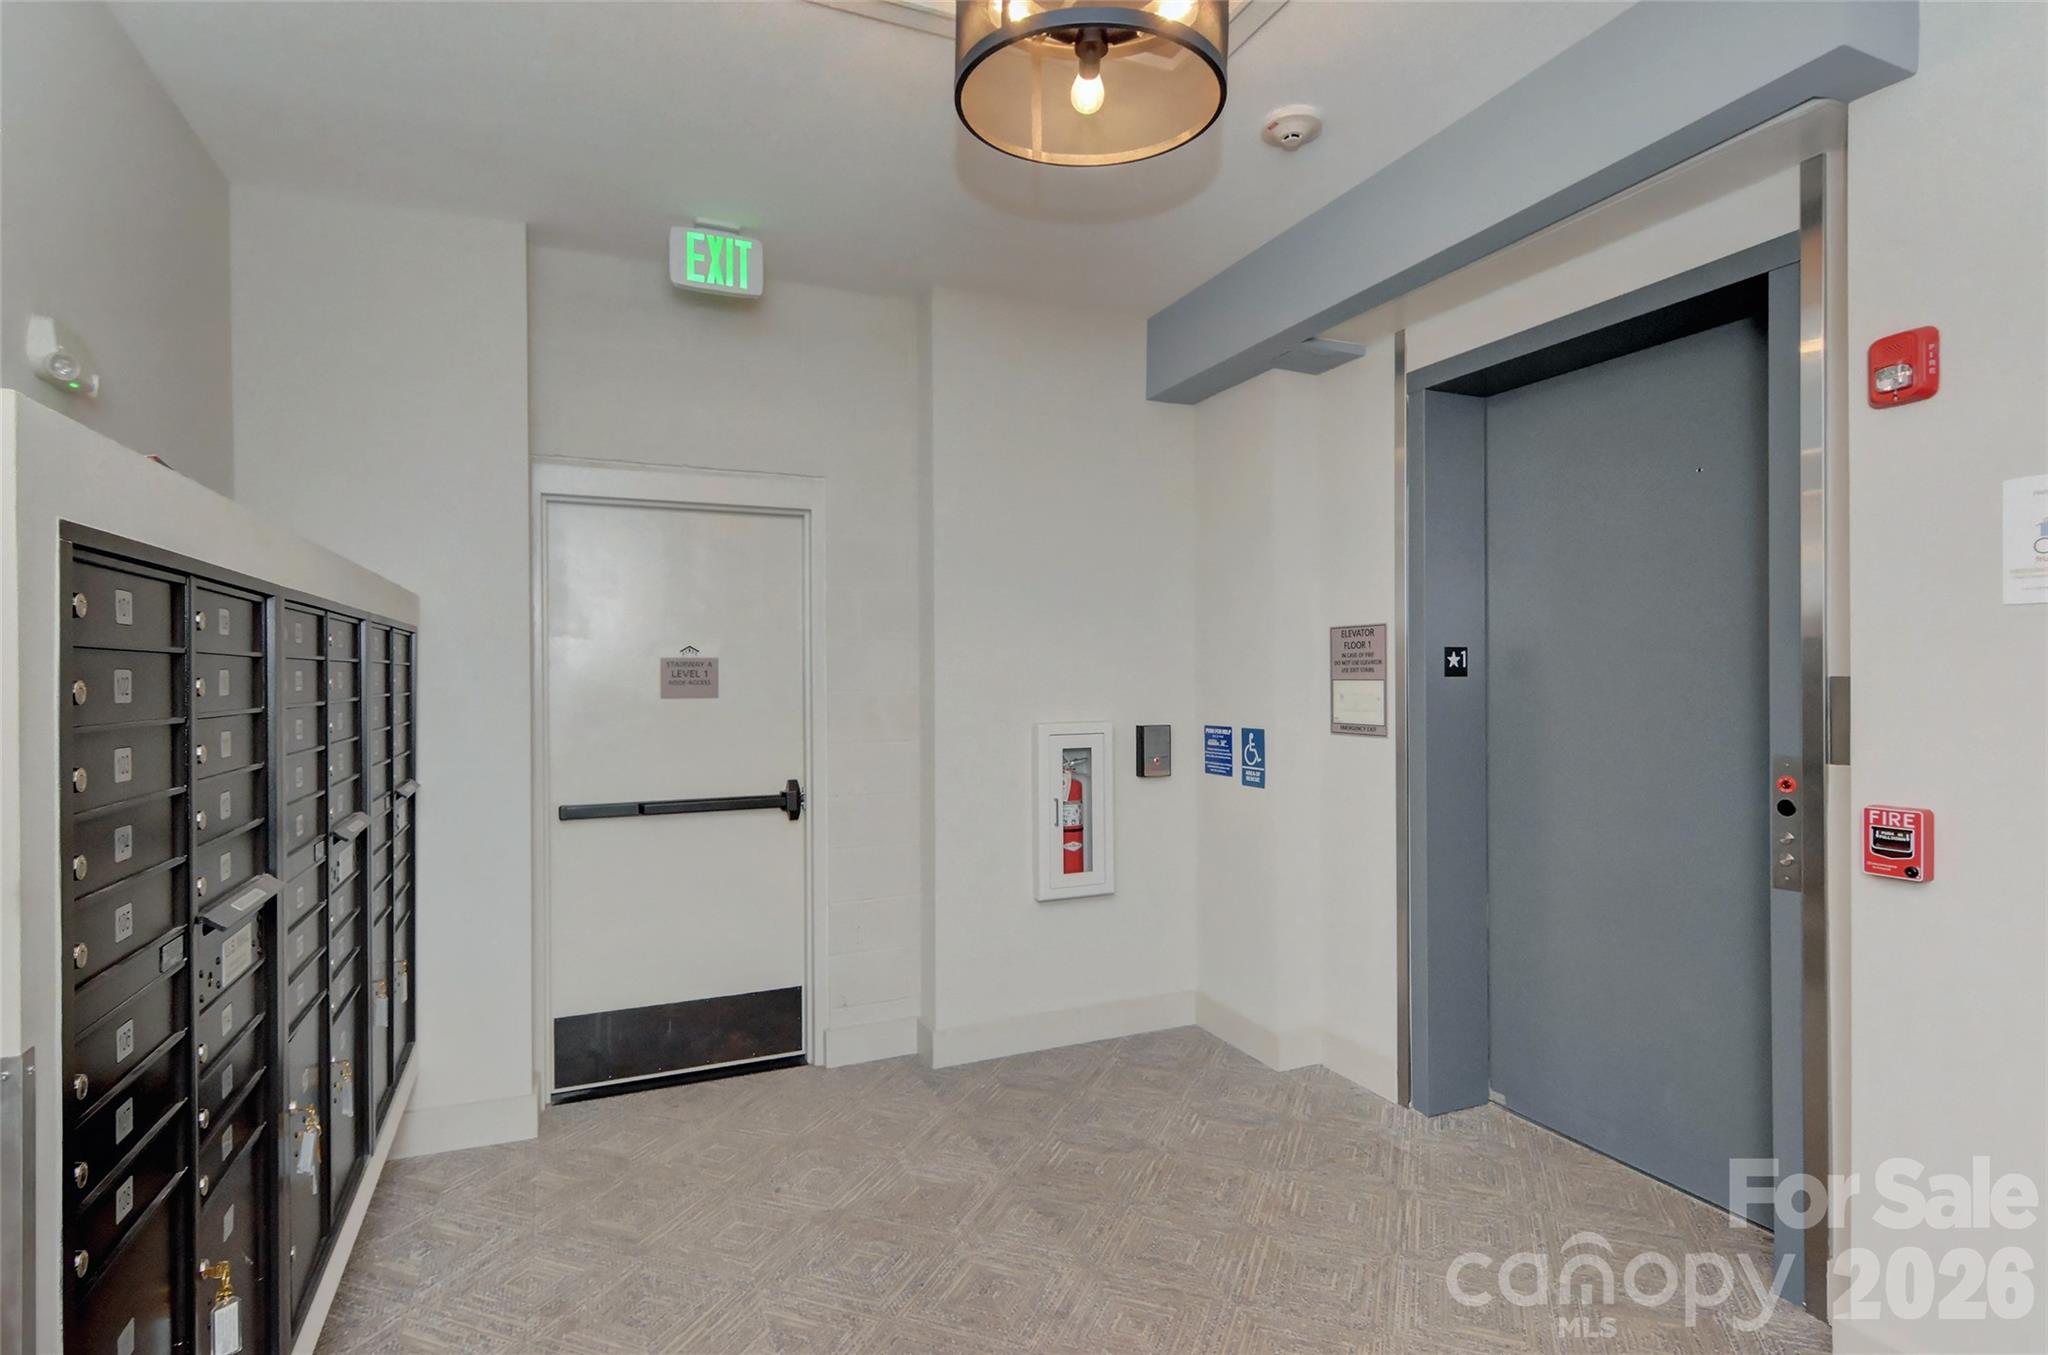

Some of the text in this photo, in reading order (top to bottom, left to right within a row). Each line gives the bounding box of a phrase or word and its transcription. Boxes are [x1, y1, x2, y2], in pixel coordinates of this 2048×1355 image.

[686, 231, 753, 289] EXIT
[1340, 628, 1375, 638] ELEVATOR
[1343, 640, 1371, 650] FLOOR 1
[1460, 650, 1466, 668] 1
[672, 670, 708, 678] LEVEL 1
[1869, 809, 1916, 828] FIRE
